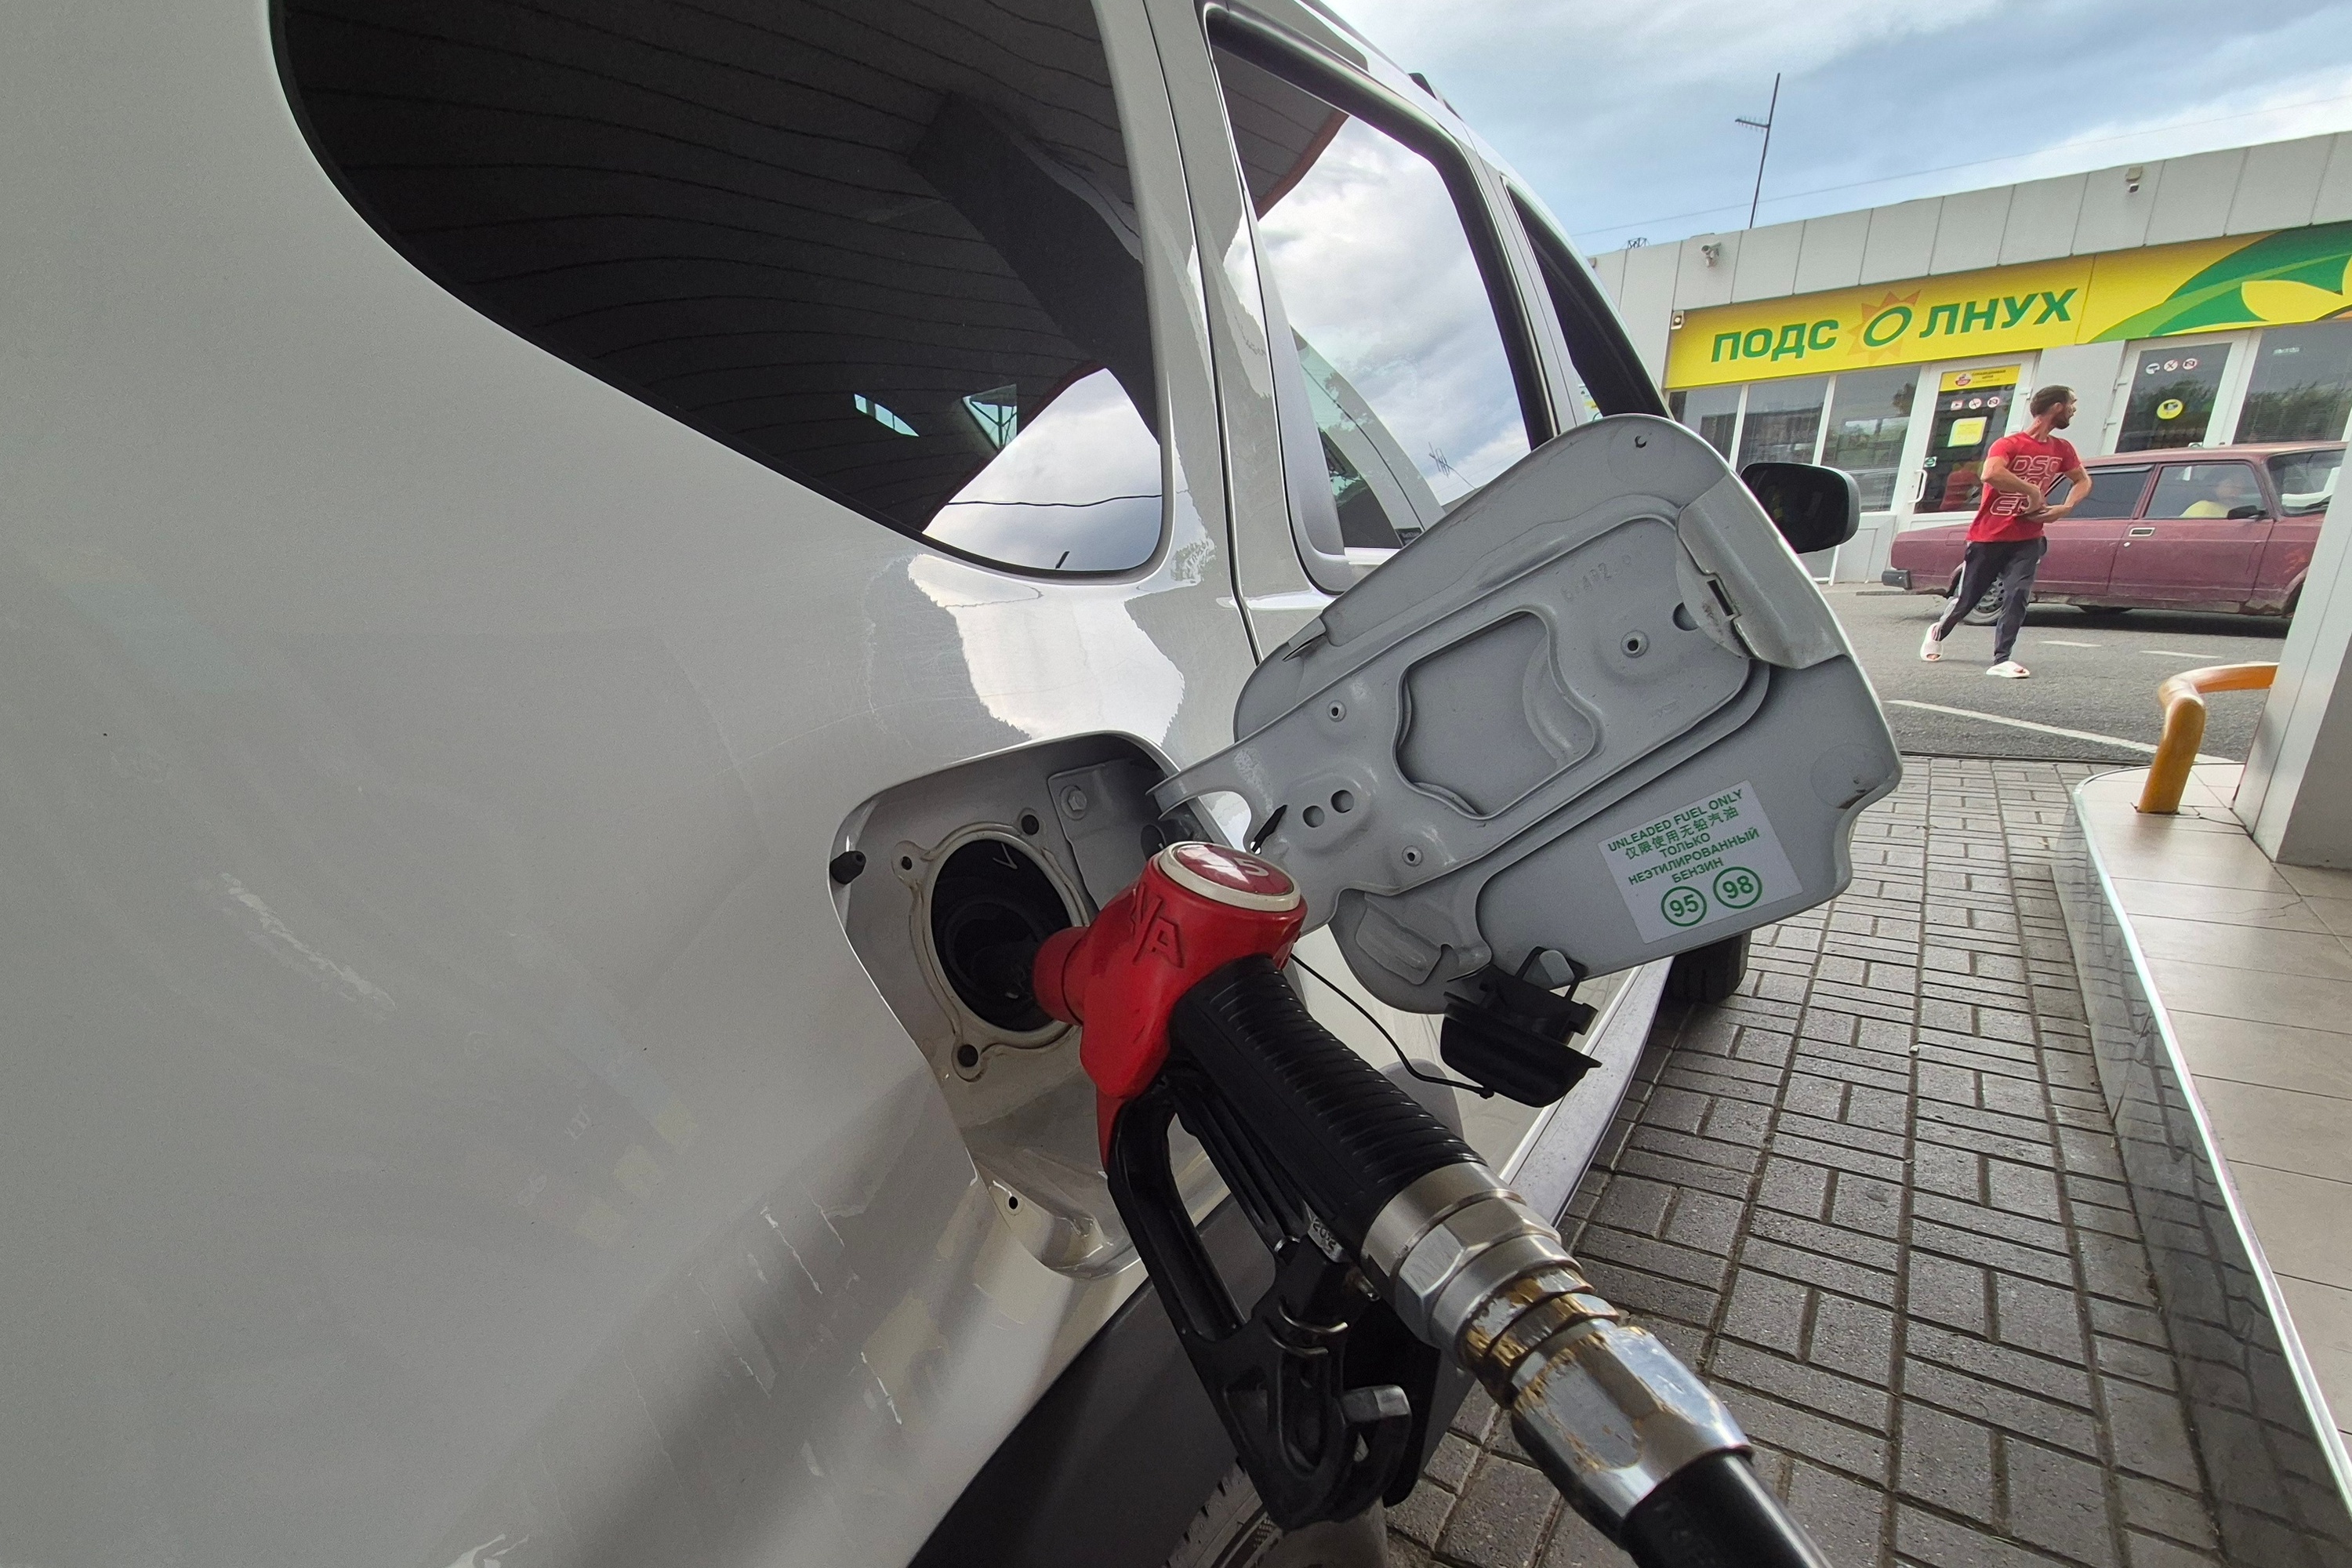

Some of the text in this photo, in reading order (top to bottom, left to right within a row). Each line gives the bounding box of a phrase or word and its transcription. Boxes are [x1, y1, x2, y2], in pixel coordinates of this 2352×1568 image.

[1711, 288, 2078, 362] ПОДСОЛНУХ
[1607, 788, 1743, 853] UNLEADED FUEL ONLY
[1624, 806, 1740, 860] 仅限使用无铅汽油
[1658, 832, 1711, 859] ТОЛЬКО
[1628, 826, 1759, 886] НЕЭТИЛИРОВАННЫЙ
[1671, 856, 1724, 884] БЕНЗИН
[1669, 874, 1755, 918] 95 98
